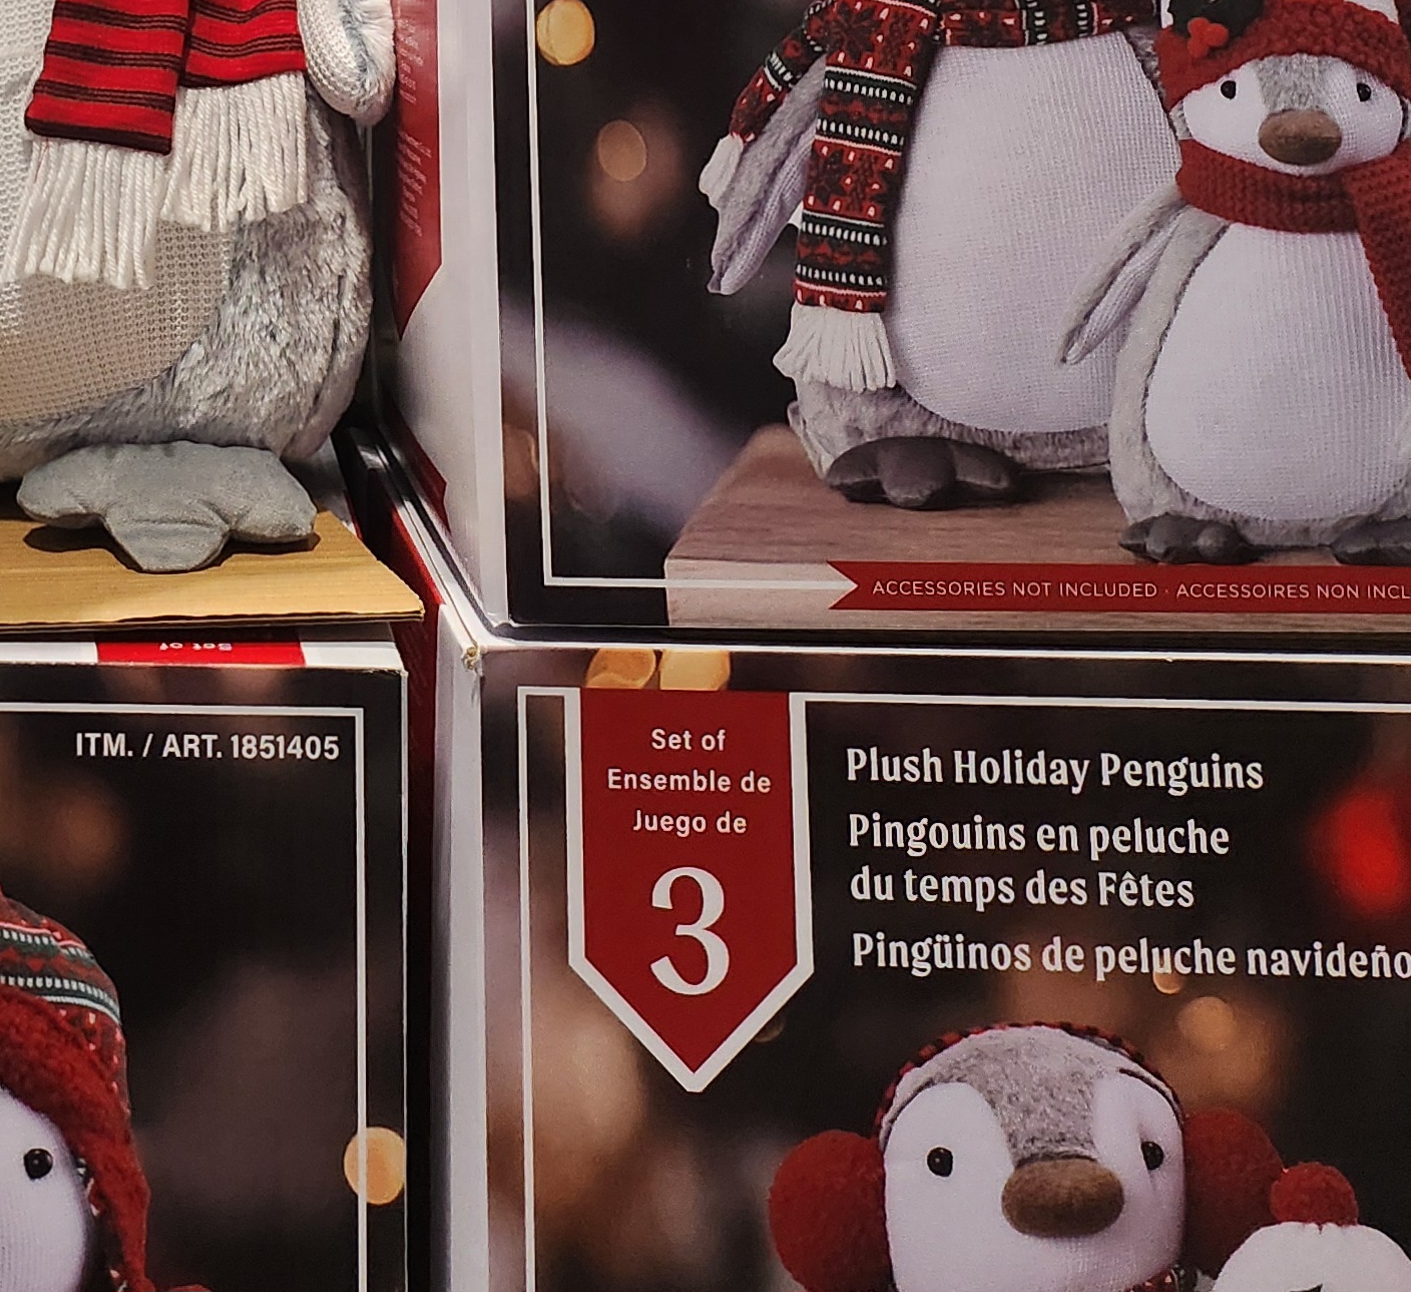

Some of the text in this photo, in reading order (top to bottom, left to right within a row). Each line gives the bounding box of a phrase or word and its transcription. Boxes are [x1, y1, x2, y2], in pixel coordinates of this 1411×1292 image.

[873, 581, 1005, 595] ACCESSORIES
[1014, 582, 1051, 596] NOT
[1060, 583, 1157, 597] INCLUDED
[1177, 584, 1309, 598] ACCESSOIRES
[1317, 585, 1358, 598] NON
[77, 733, 338, 759] ITM. / ART. 1851405
[652, 729, 725, 750] Set of
[608, 769, 770, 792] Ensemble de
[847, 747, 1263, 796] Plush Holiday Penguins
[634, 810, 746, 837] Juego de
[850, 812, 1228, 860] Pingouins en peluche
[851, 865, 1194, 912] du temps des Fêtes
[651, 867, 729, 995] 3
[853, 932, 1031, 976] Pingüinos
[1042, 936, 1084, 972] de
[1095, 938, 1235, 982] peluche
